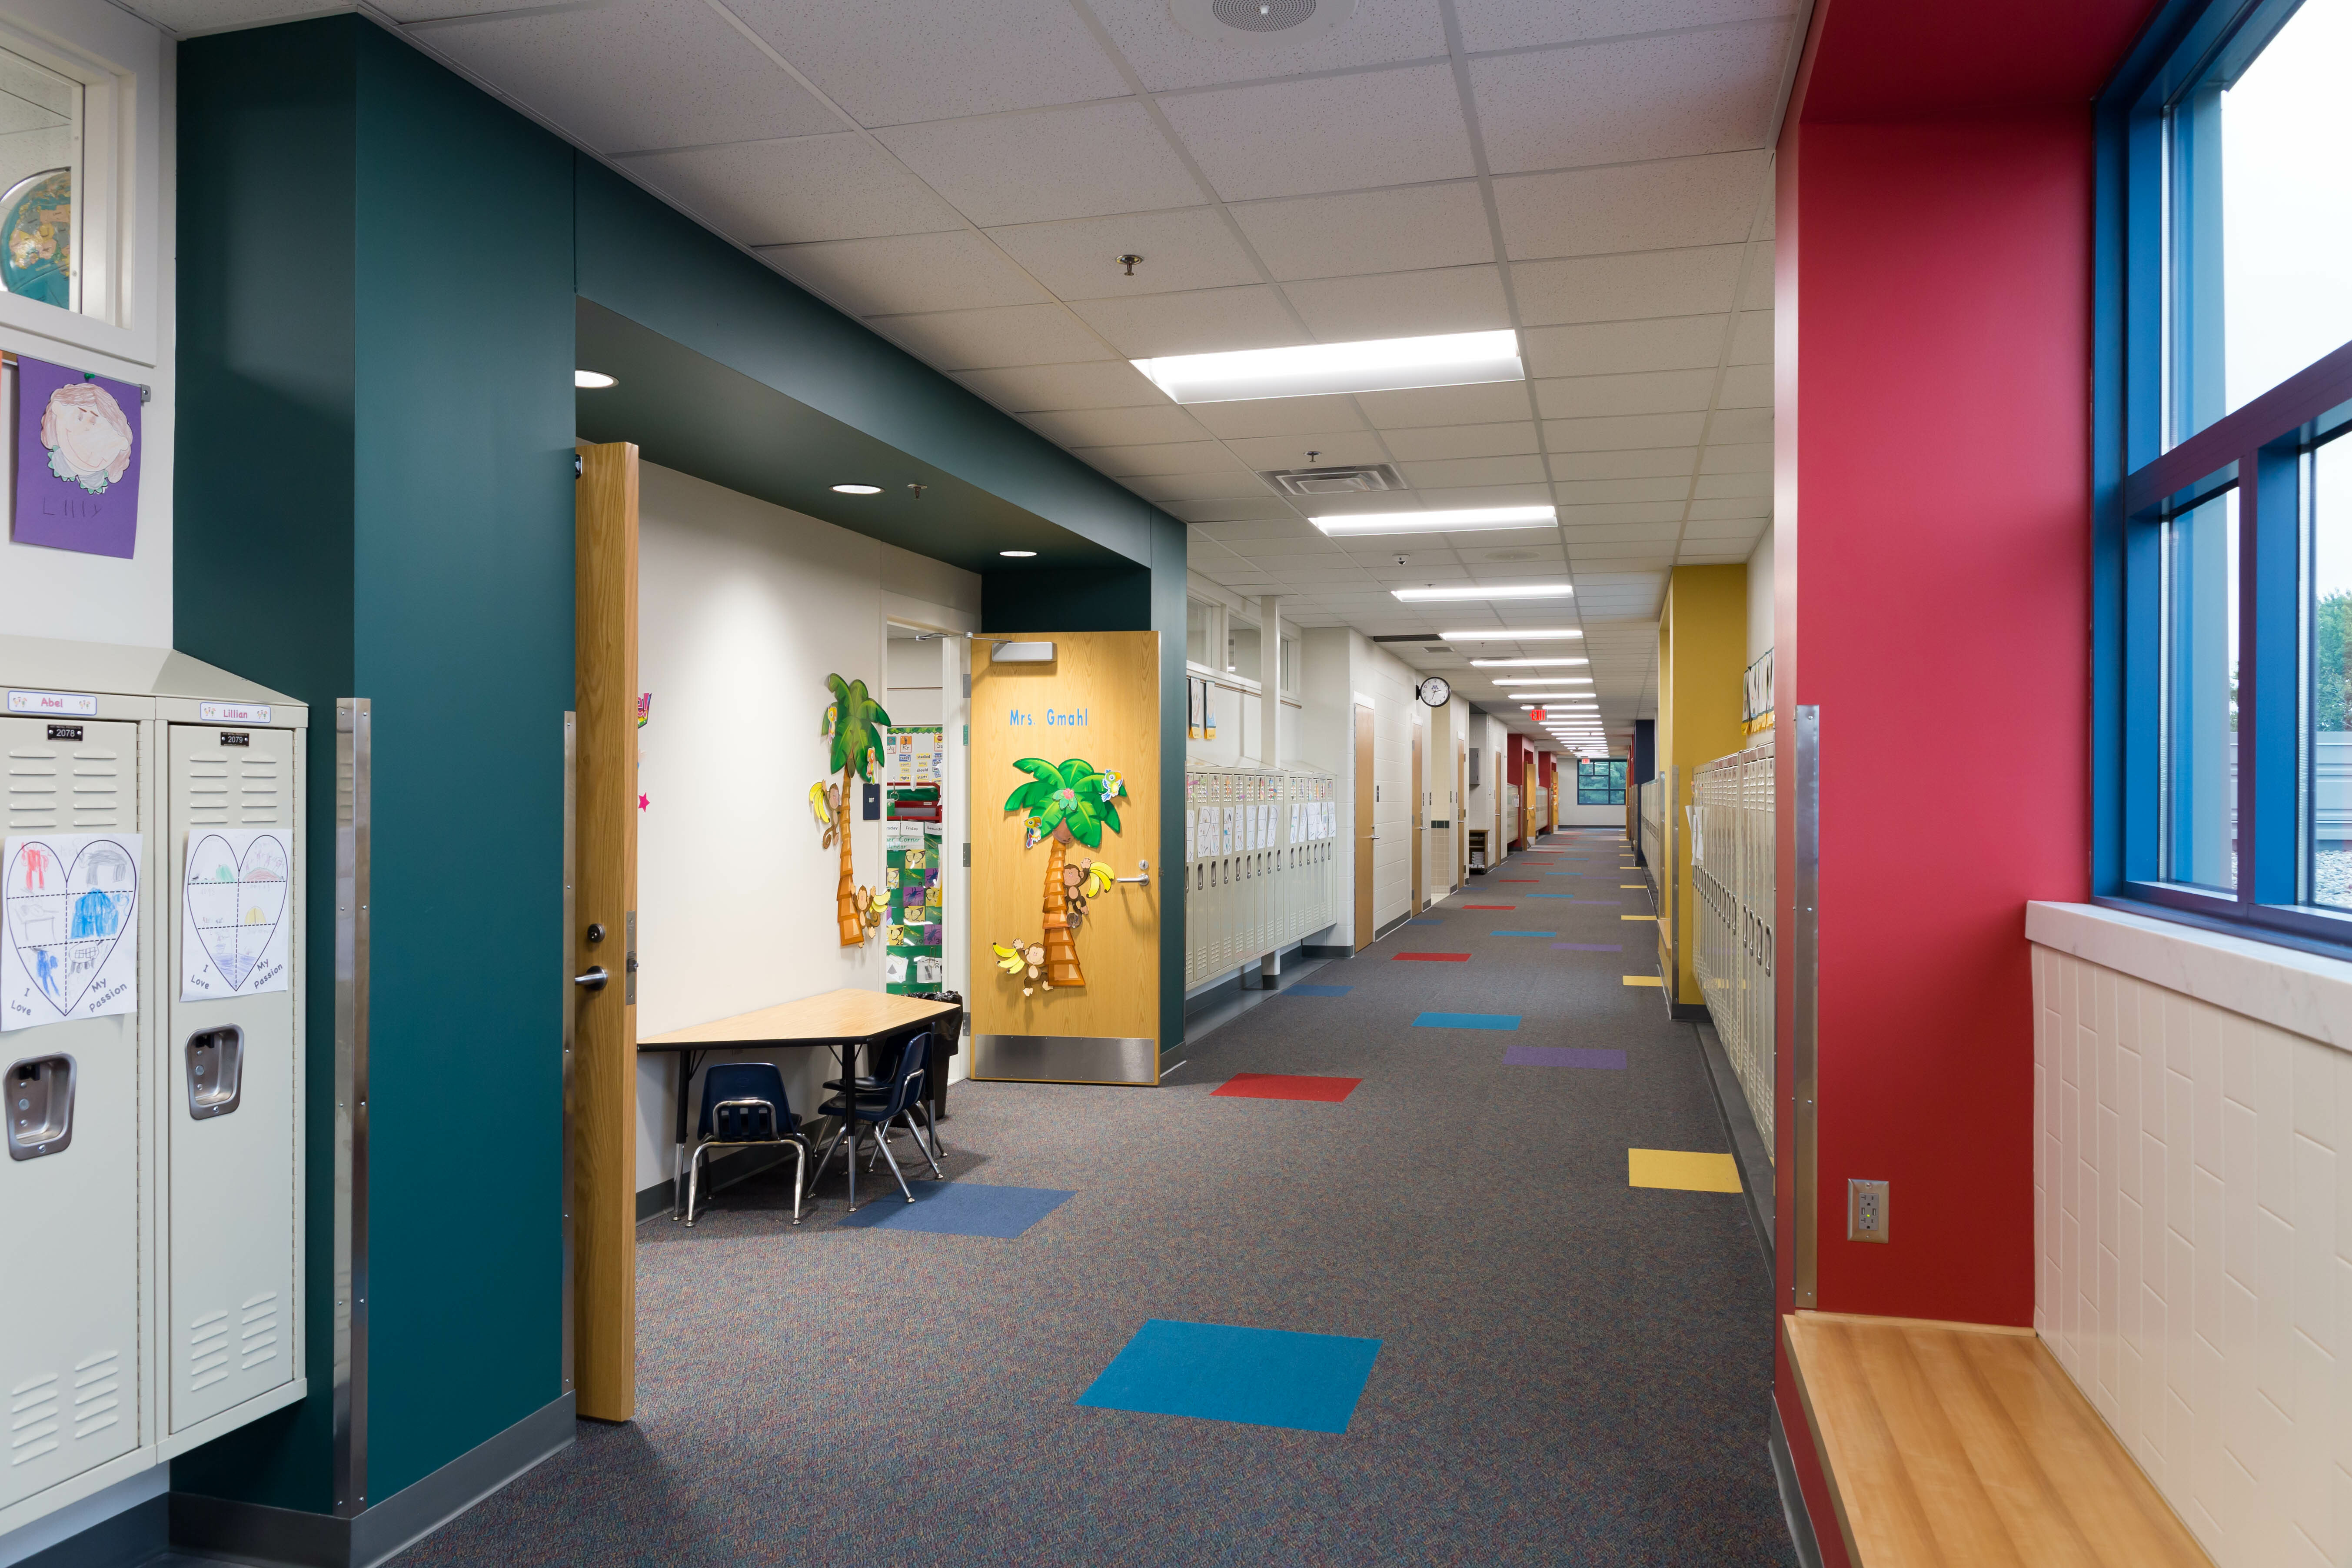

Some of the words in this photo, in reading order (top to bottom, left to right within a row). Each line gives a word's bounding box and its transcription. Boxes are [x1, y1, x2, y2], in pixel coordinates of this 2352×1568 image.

[41, 697, 63, 708] Abel
[223, 709, 248, 719] Lillian
[1010, 709, 1035, 726] Mrs.
[1047, 708, 1088, 726] Gmahl
[1531, 709, 1546, 721] EXIT
[203, 964, 209, 972] I
[257, 959, 269, 972] My
[91, 978, 106, 992] My
[191, 975, 210, 989] Love
[24, 988, 30, 997] I
[11, 1000, 32, 1015] Love
